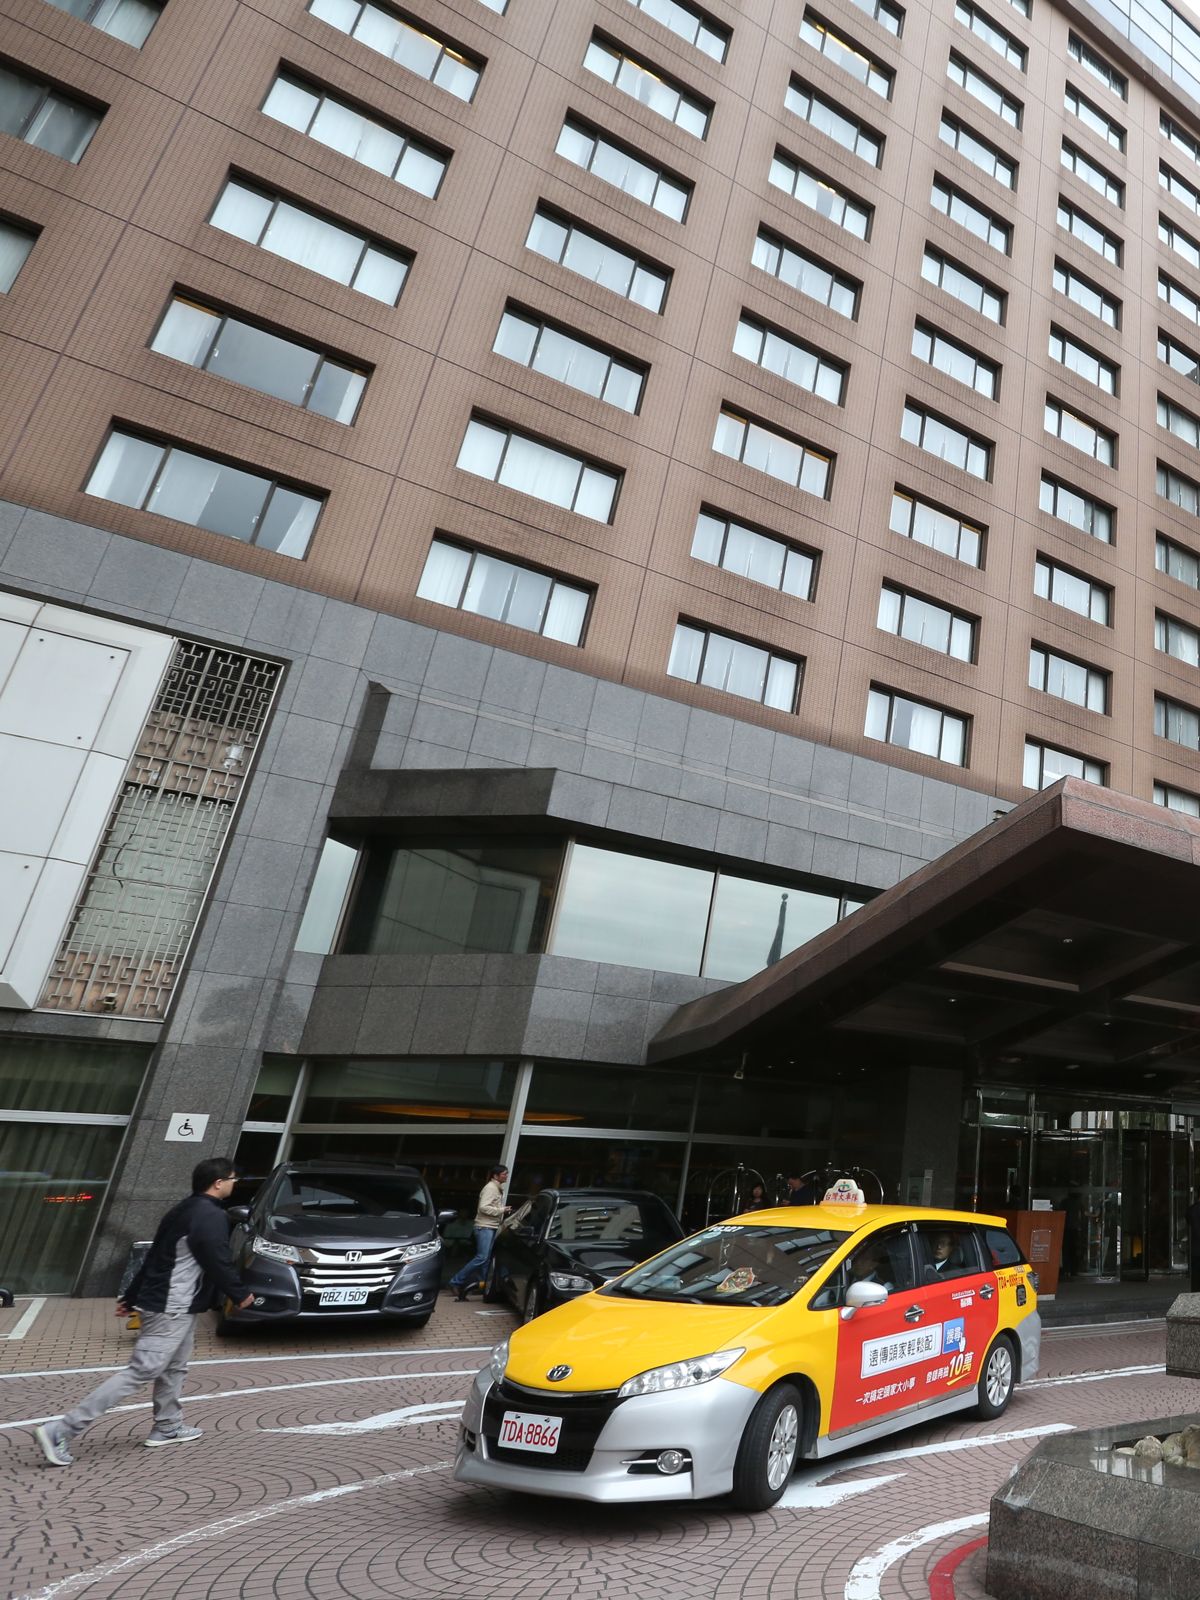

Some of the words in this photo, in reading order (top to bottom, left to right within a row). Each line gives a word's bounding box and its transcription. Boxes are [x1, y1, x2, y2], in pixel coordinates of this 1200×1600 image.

[869, 1334, 933, 1368] 遠傳頭家輕鬆配
